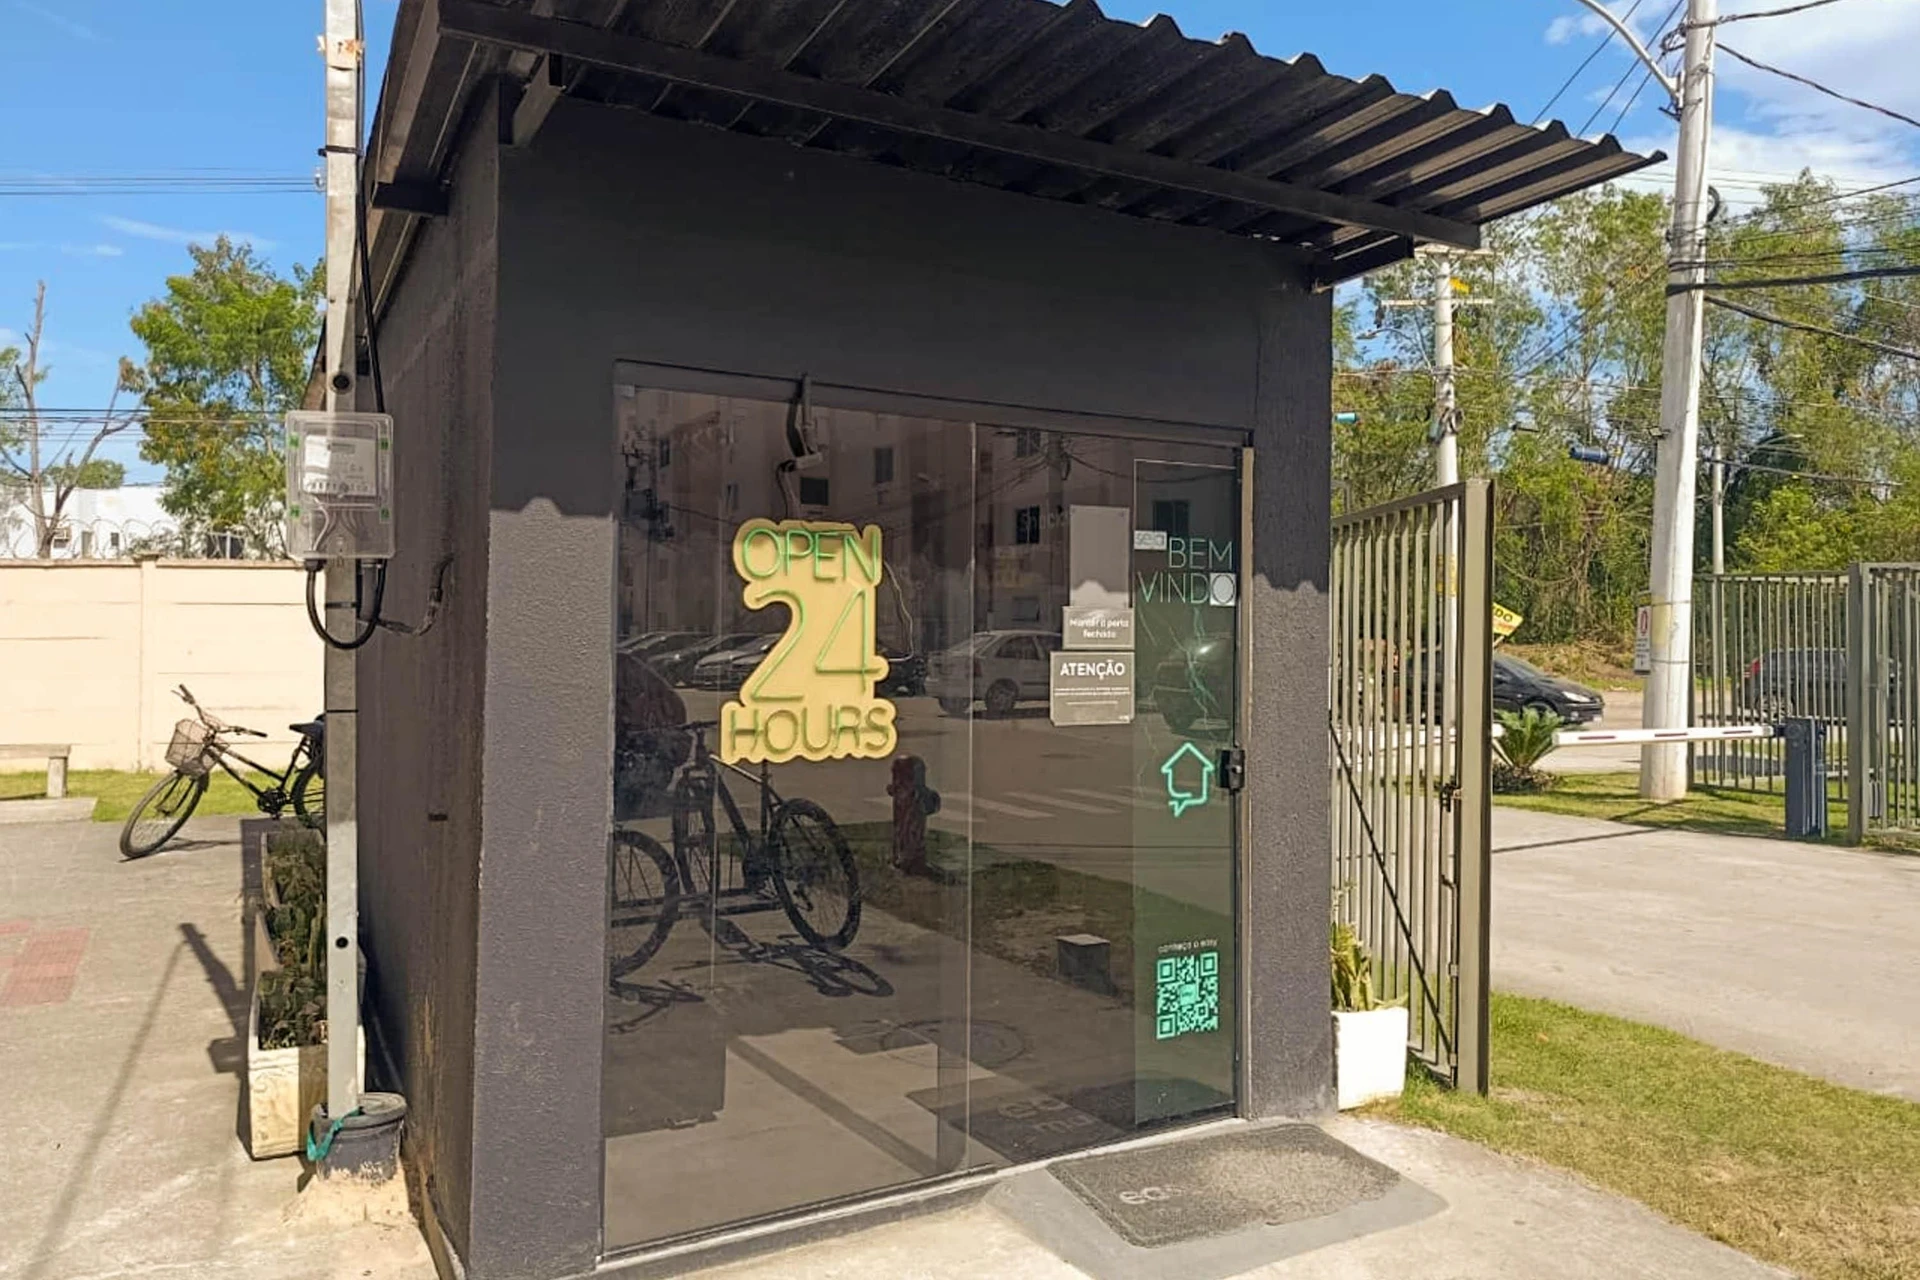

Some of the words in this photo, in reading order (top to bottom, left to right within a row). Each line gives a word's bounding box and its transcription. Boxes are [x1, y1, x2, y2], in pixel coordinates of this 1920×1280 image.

[742, 527, 879, 583] OPEN
[1168, 536, 1233, 571] BEM
[1137, 571, 1236, 605] VINDO
[750, 587, 882, 702] 24
[1060, 659, 1126, 681] ATENÇÃO
[729, 704, 891, 758] HOURS
